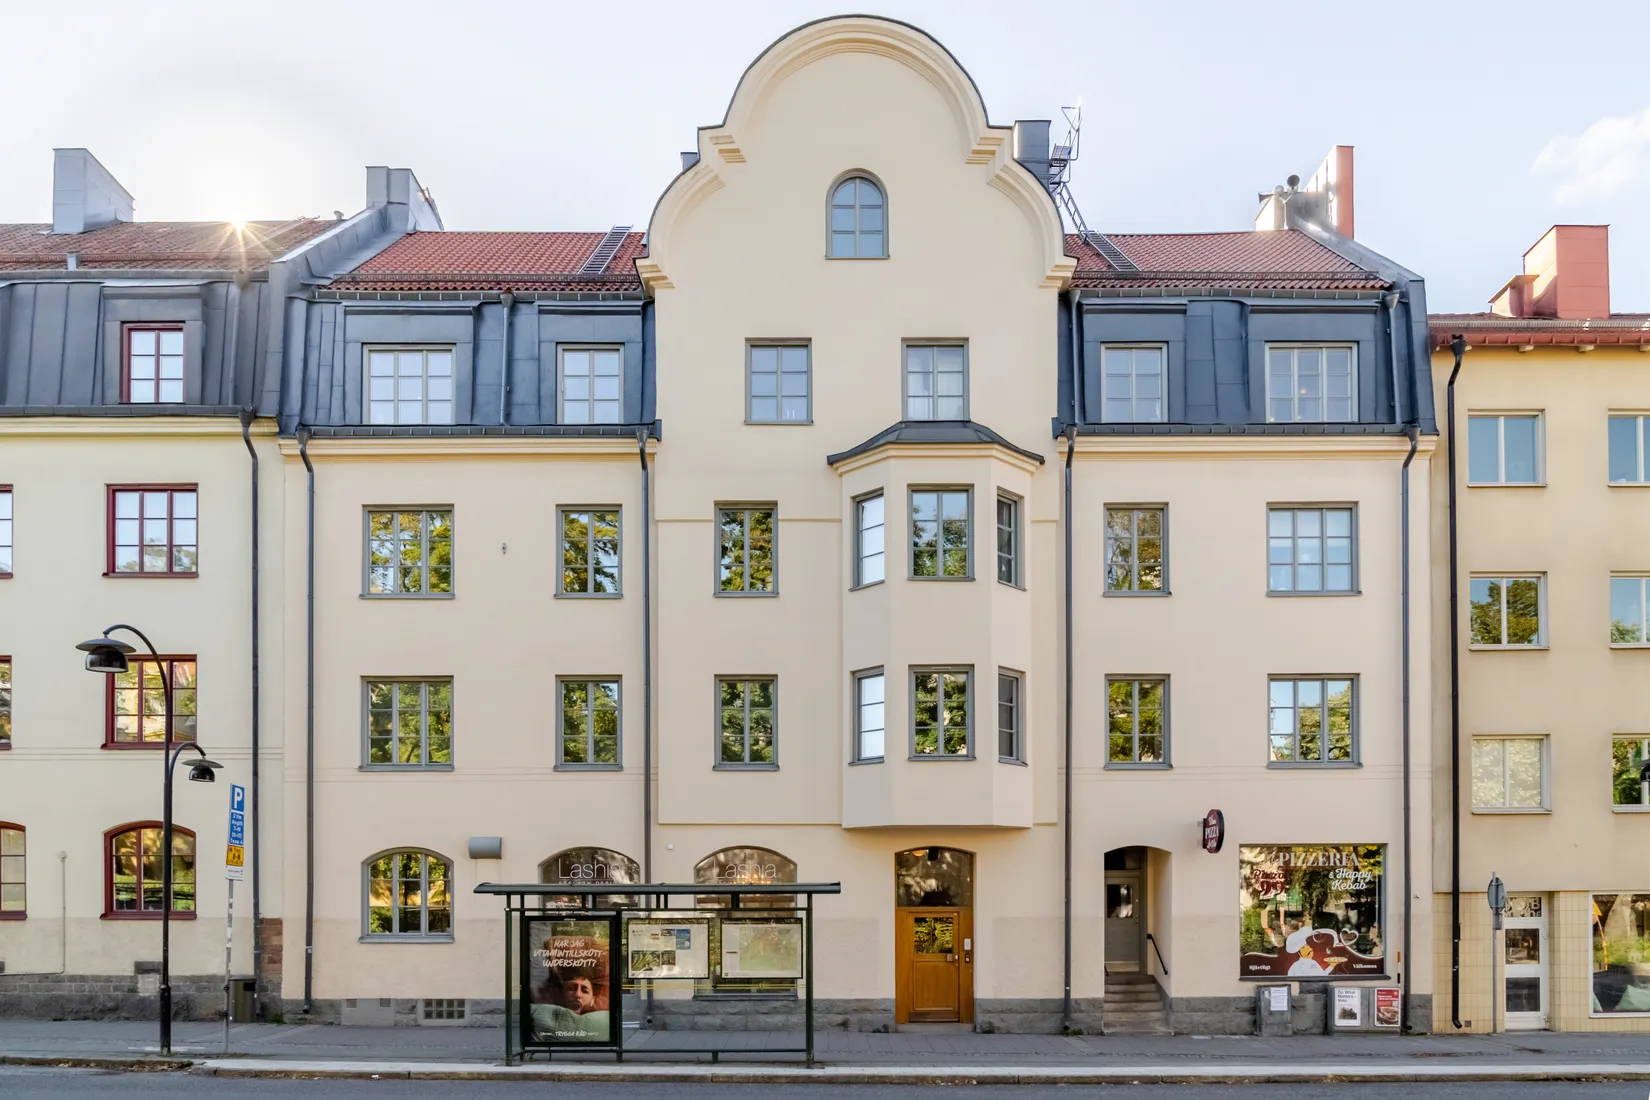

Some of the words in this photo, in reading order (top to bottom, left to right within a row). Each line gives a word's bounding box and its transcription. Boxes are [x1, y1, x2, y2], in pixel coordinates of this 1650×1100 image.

[234, 787, 243, 809] P
[1279, 852, 1359, 867] PIZZERIA
[713, 858, 777, 879] Lashia
[1335, 868, 1373, 882] Happy
[1331, 880, 1367, 890] Kebab
[570, 939, 584, 947] JAG
[542, 959, 597, 967] UNDERSKOTT?
